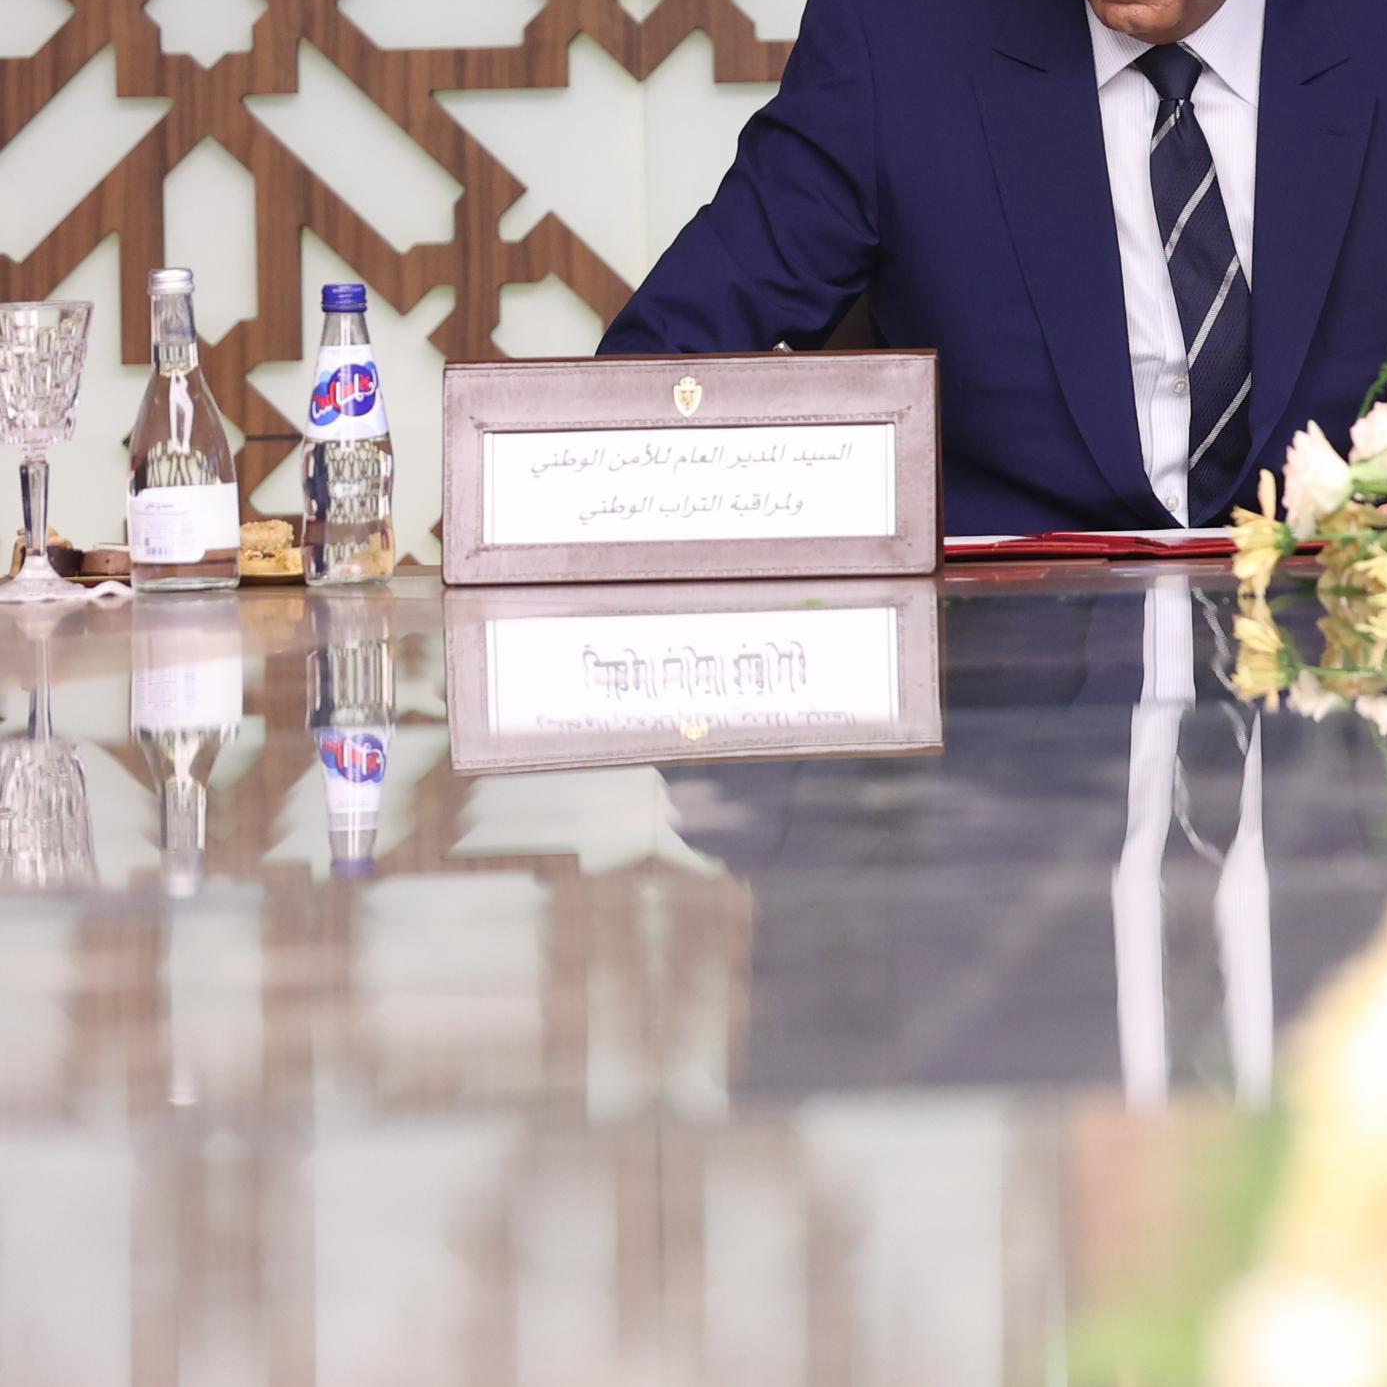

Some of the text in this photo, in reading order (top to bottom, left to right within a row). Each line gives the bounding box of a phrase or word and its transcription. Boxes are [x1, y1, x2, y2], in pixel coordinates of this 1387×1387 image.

[530, 442, 854, 480] السيد المدير العام للأمن الوطني
[578, 491, 805, 527] ولمراقبة التراب الوطني
